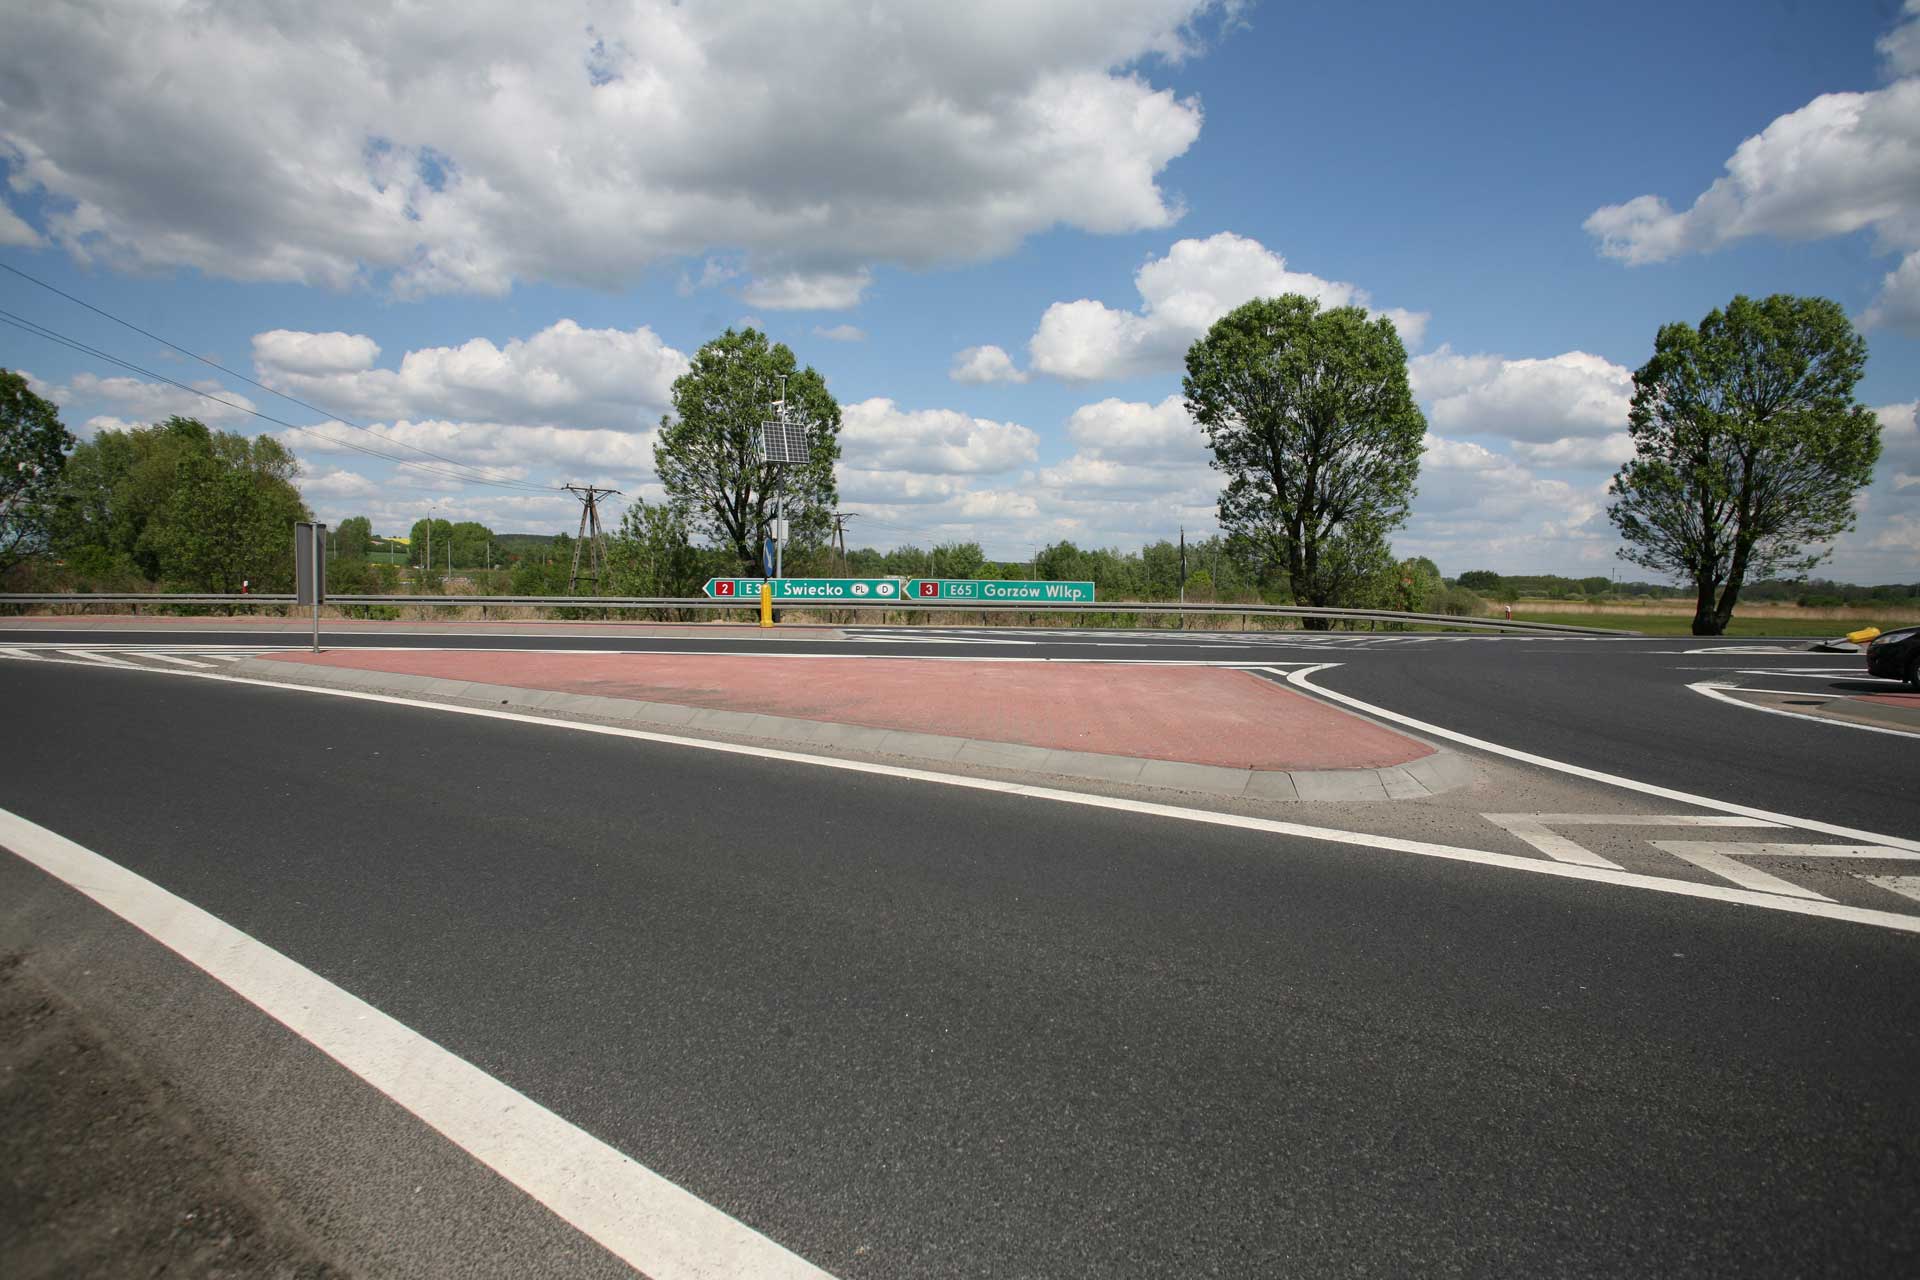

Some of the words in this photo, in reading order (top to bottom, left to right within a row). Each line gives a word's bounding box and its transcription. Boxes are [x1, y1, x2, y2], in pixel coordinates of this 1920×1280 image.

[721, 584, 729, 594] 2
[783, 580, 843, 596] Świecko
[855, 585, 865, 594] PL
[881, 585, 889, 594] D
[925, 584, 933, 595] 3
[950, 585, 972, 596] E65
[984, 583, 1041, 597] Gorzów
[1045, 585, 1086, 602] Wlkp.
